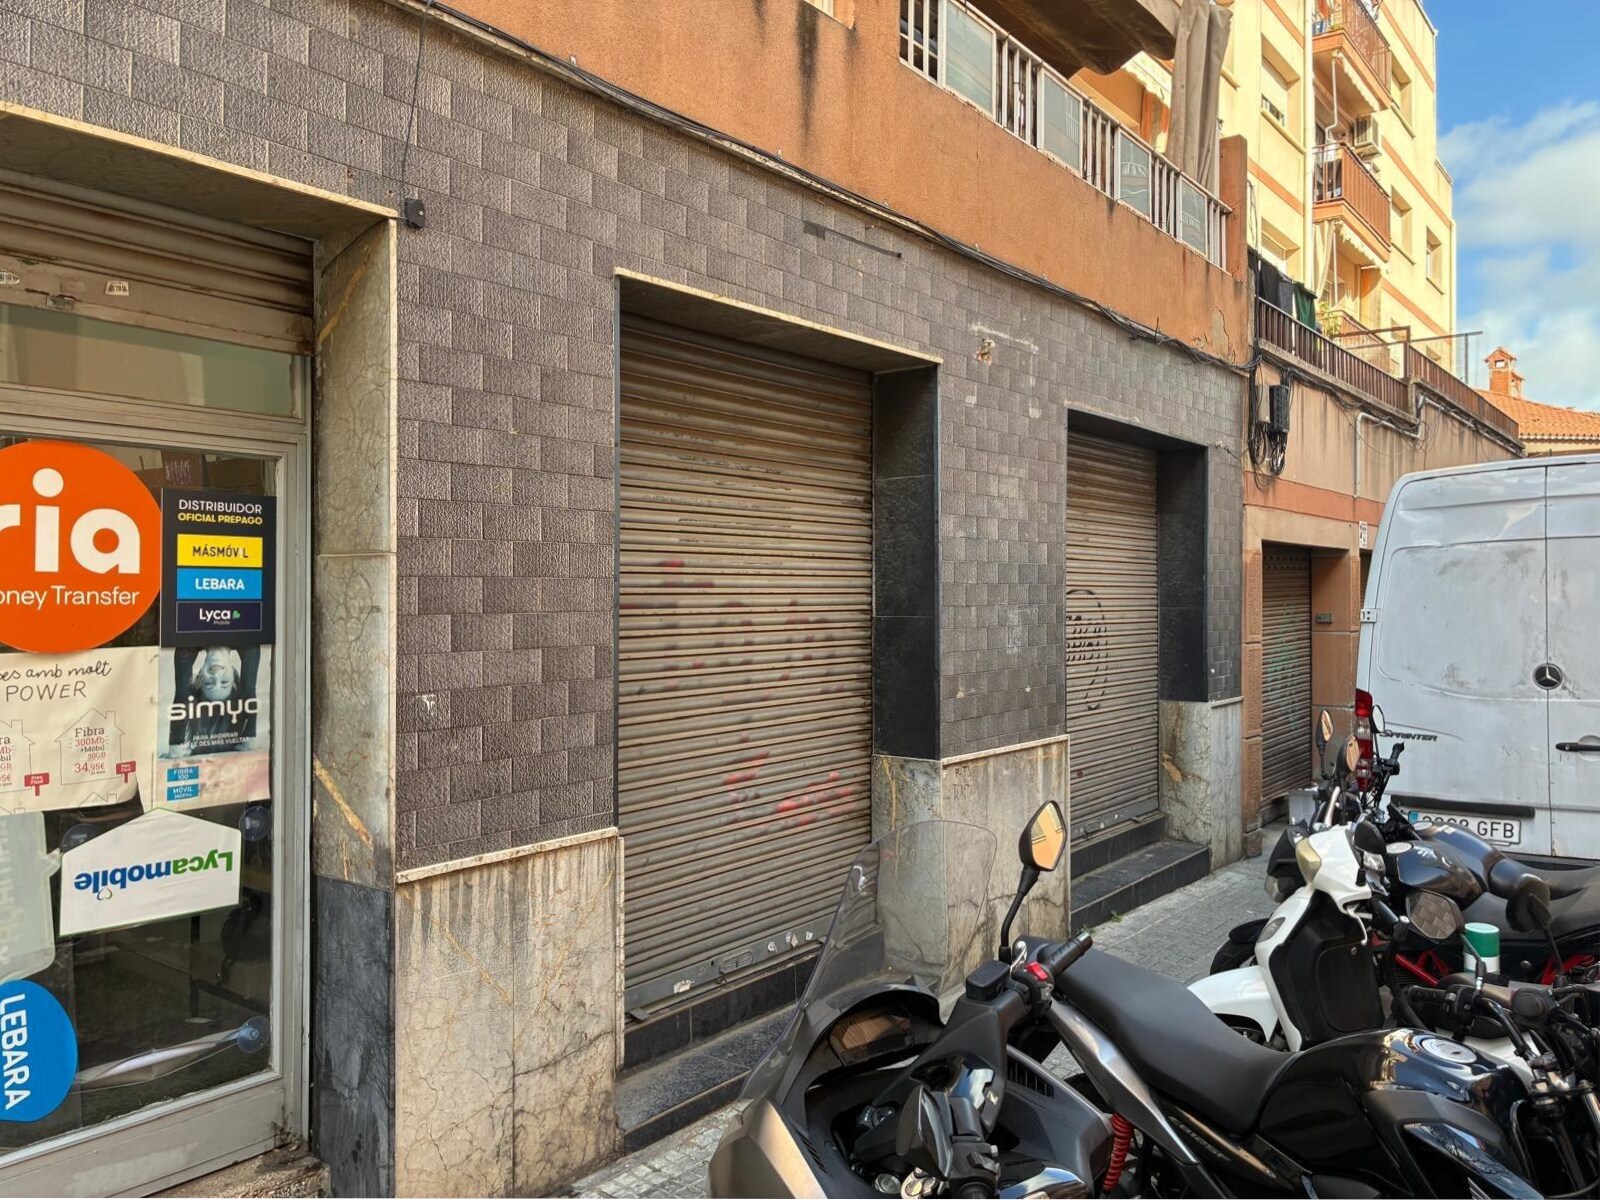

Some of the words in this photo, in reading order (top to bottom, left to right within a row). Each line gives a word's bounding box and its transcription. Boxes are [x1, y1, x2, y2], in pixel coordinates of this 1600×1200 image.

[178, 499, 263, 514] DISTRIBUIDOR
[177, 512, 217, 524] OFICIAL
[217, 515, 263, 525] PREPAGO
[192, 544, 249, 559] MÁSMÓVL
[195, 578, 245, 590] LEBARA
[51, 585, 140, 606] Transfer
[199, 608, 231, 622] Lyca
[26, 664, 63, 678] amb
[68, 660, 112, 677] molt
[5, 680, 87, 702] POWER
[74, 726, 105, 738] Fibra
[1379, 729, 1438, 742] SPRINTER
[1477, 820, 1514, 839] GFB
[74, 849, 233, 894] Lycamobile
[0, 994, 32, 1110] LEBARA
